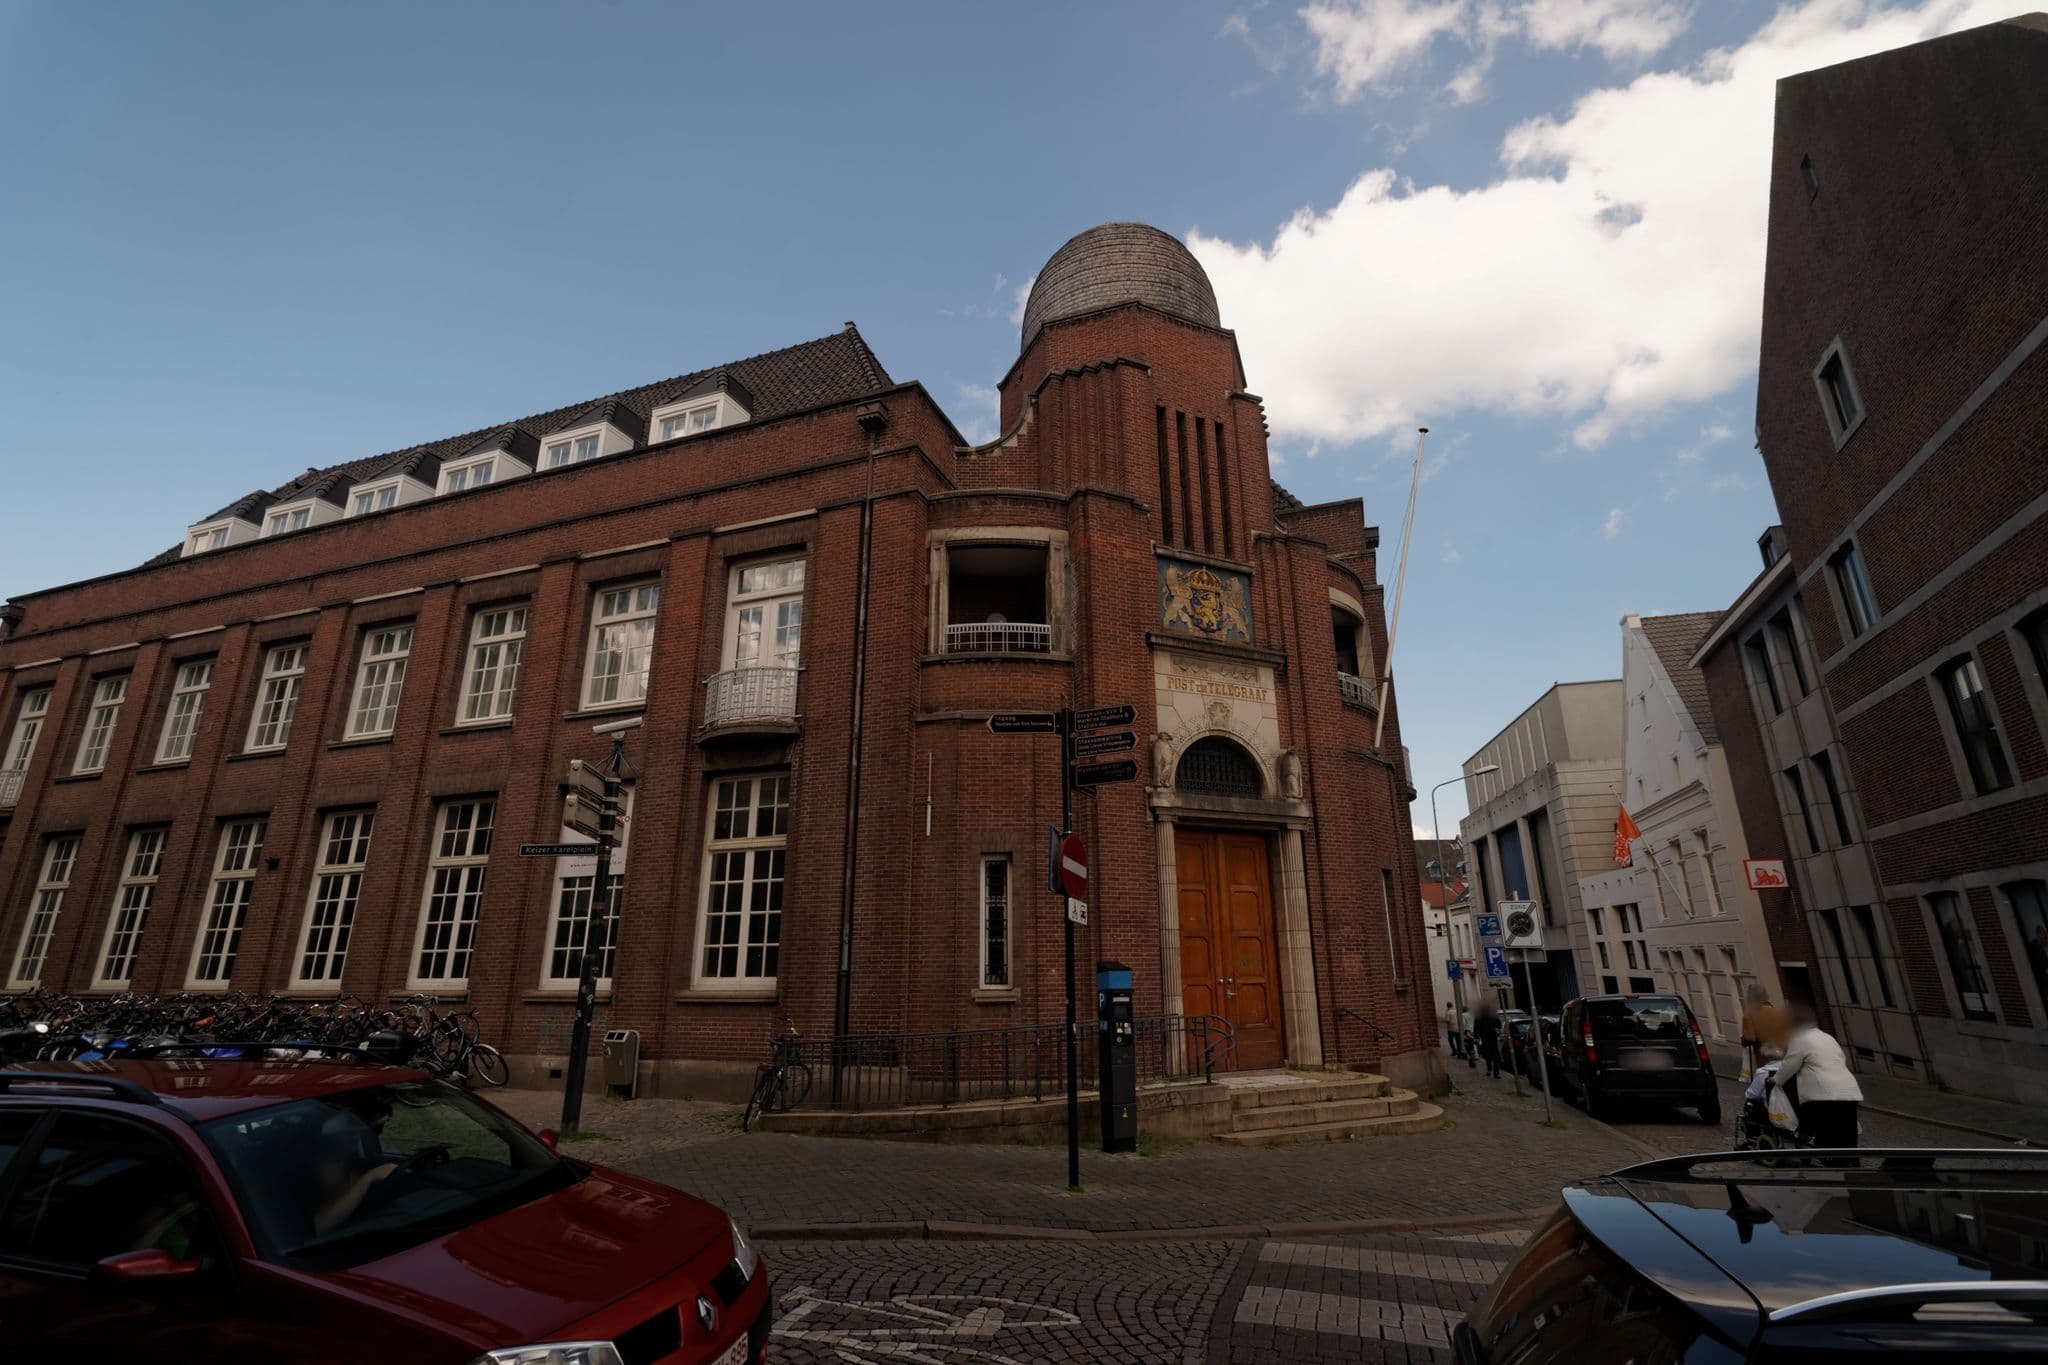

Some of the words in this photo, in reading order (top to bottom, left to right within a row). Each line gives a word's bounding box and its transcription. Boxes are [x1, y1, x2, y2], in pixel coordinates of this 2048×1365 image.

[1167, 676, 1195, 692] POST
[1208, 682, 1268, 701] TELEGRAAF
[525, 846, 551, 854] Keizer
[553, 846, 592, 854] Karelplein
[1487, 948, 1501, 964] P
